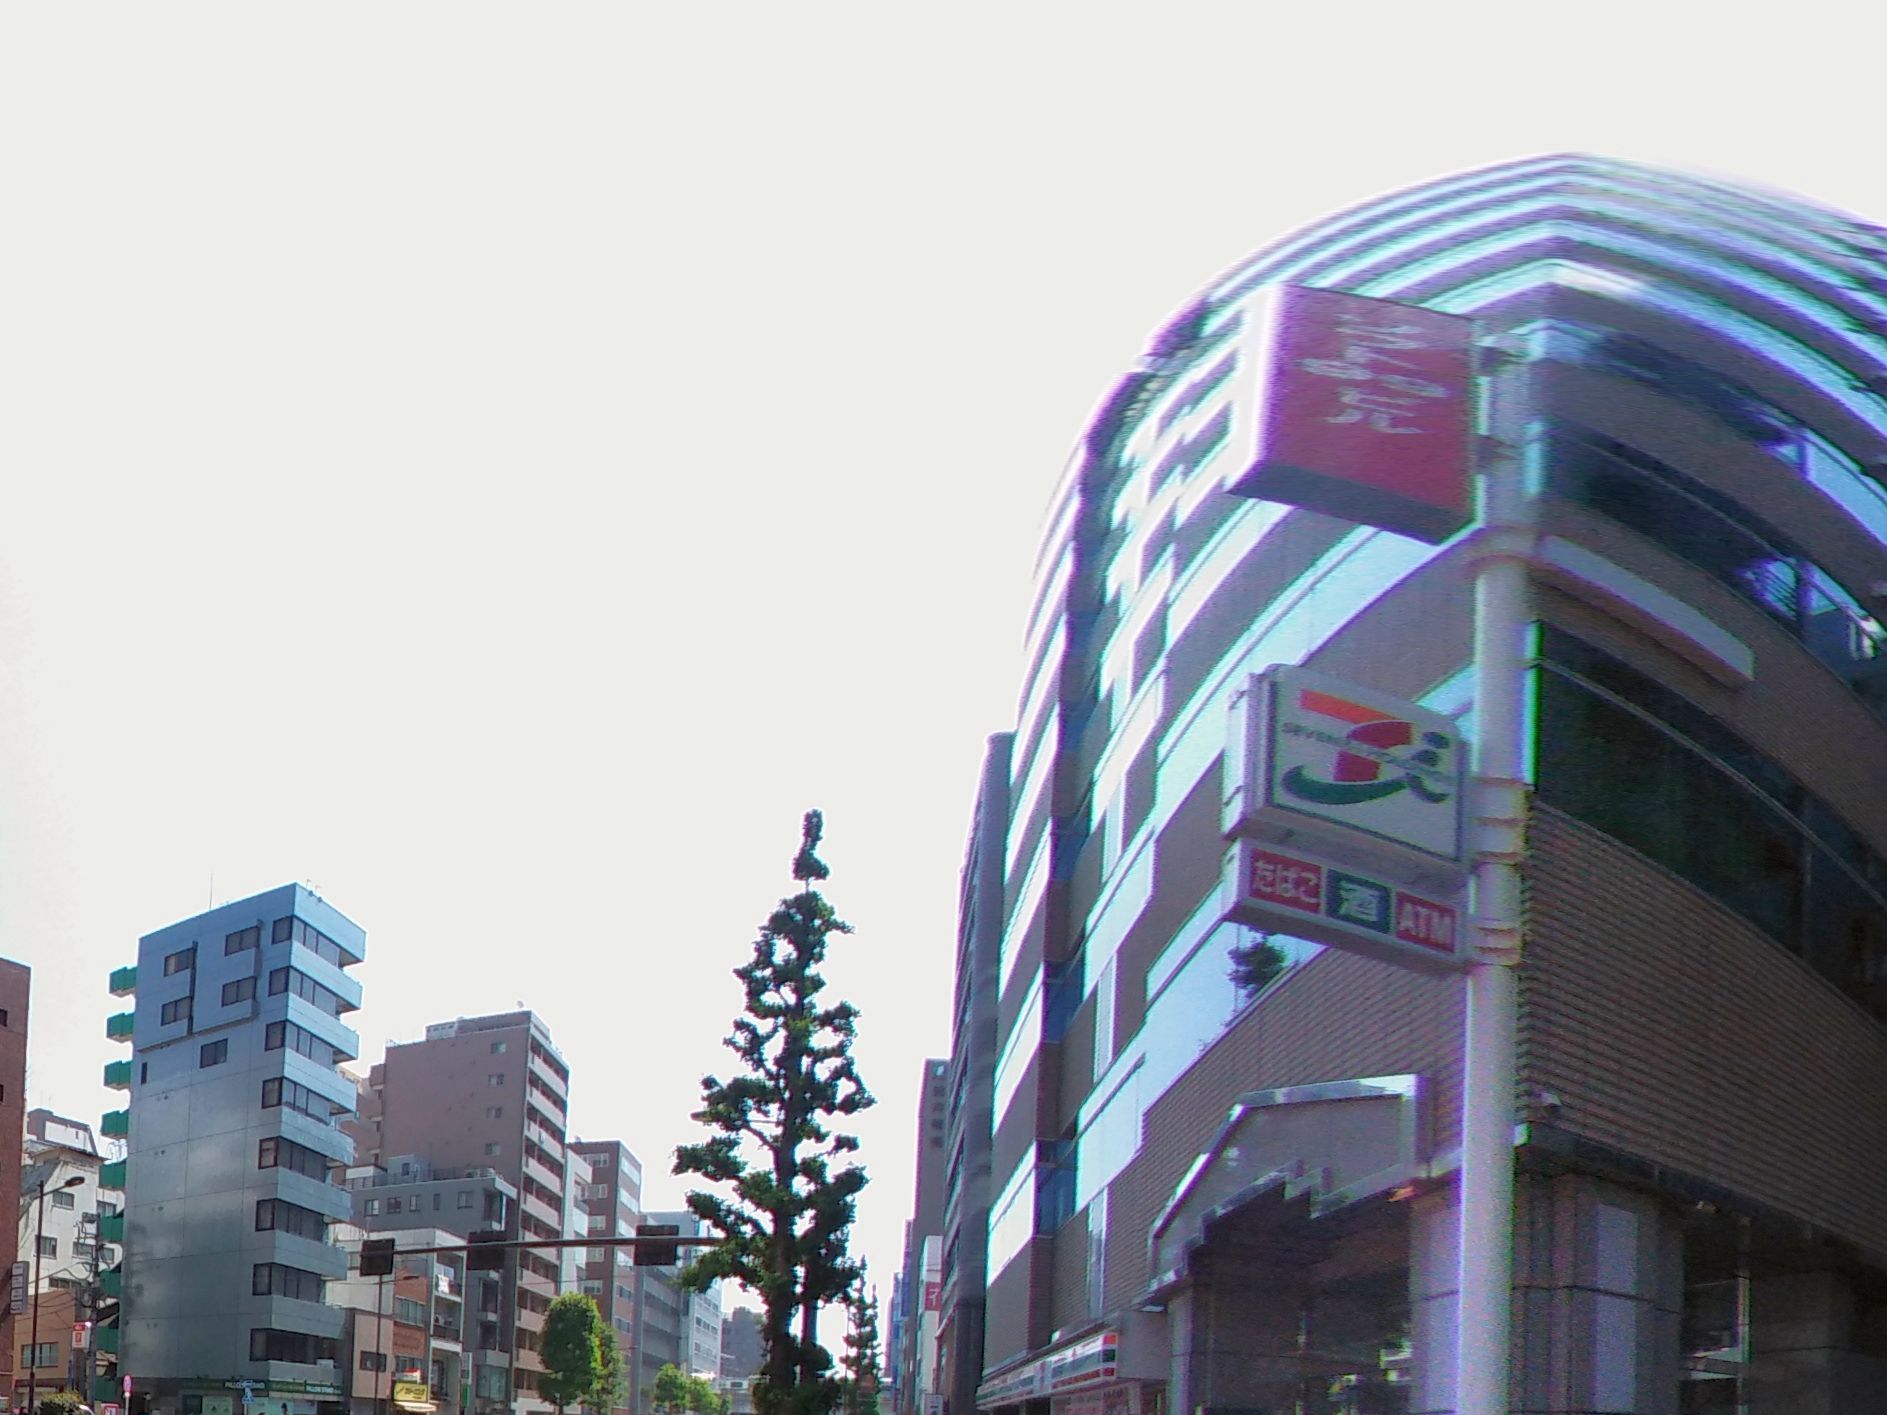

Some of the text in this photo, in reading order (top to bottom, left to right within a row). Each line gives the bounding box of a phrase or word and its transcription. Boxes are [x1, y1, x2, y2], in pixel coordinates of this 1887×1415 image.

[1255, 858, 1455, 947] たばこ 酒 ATM
